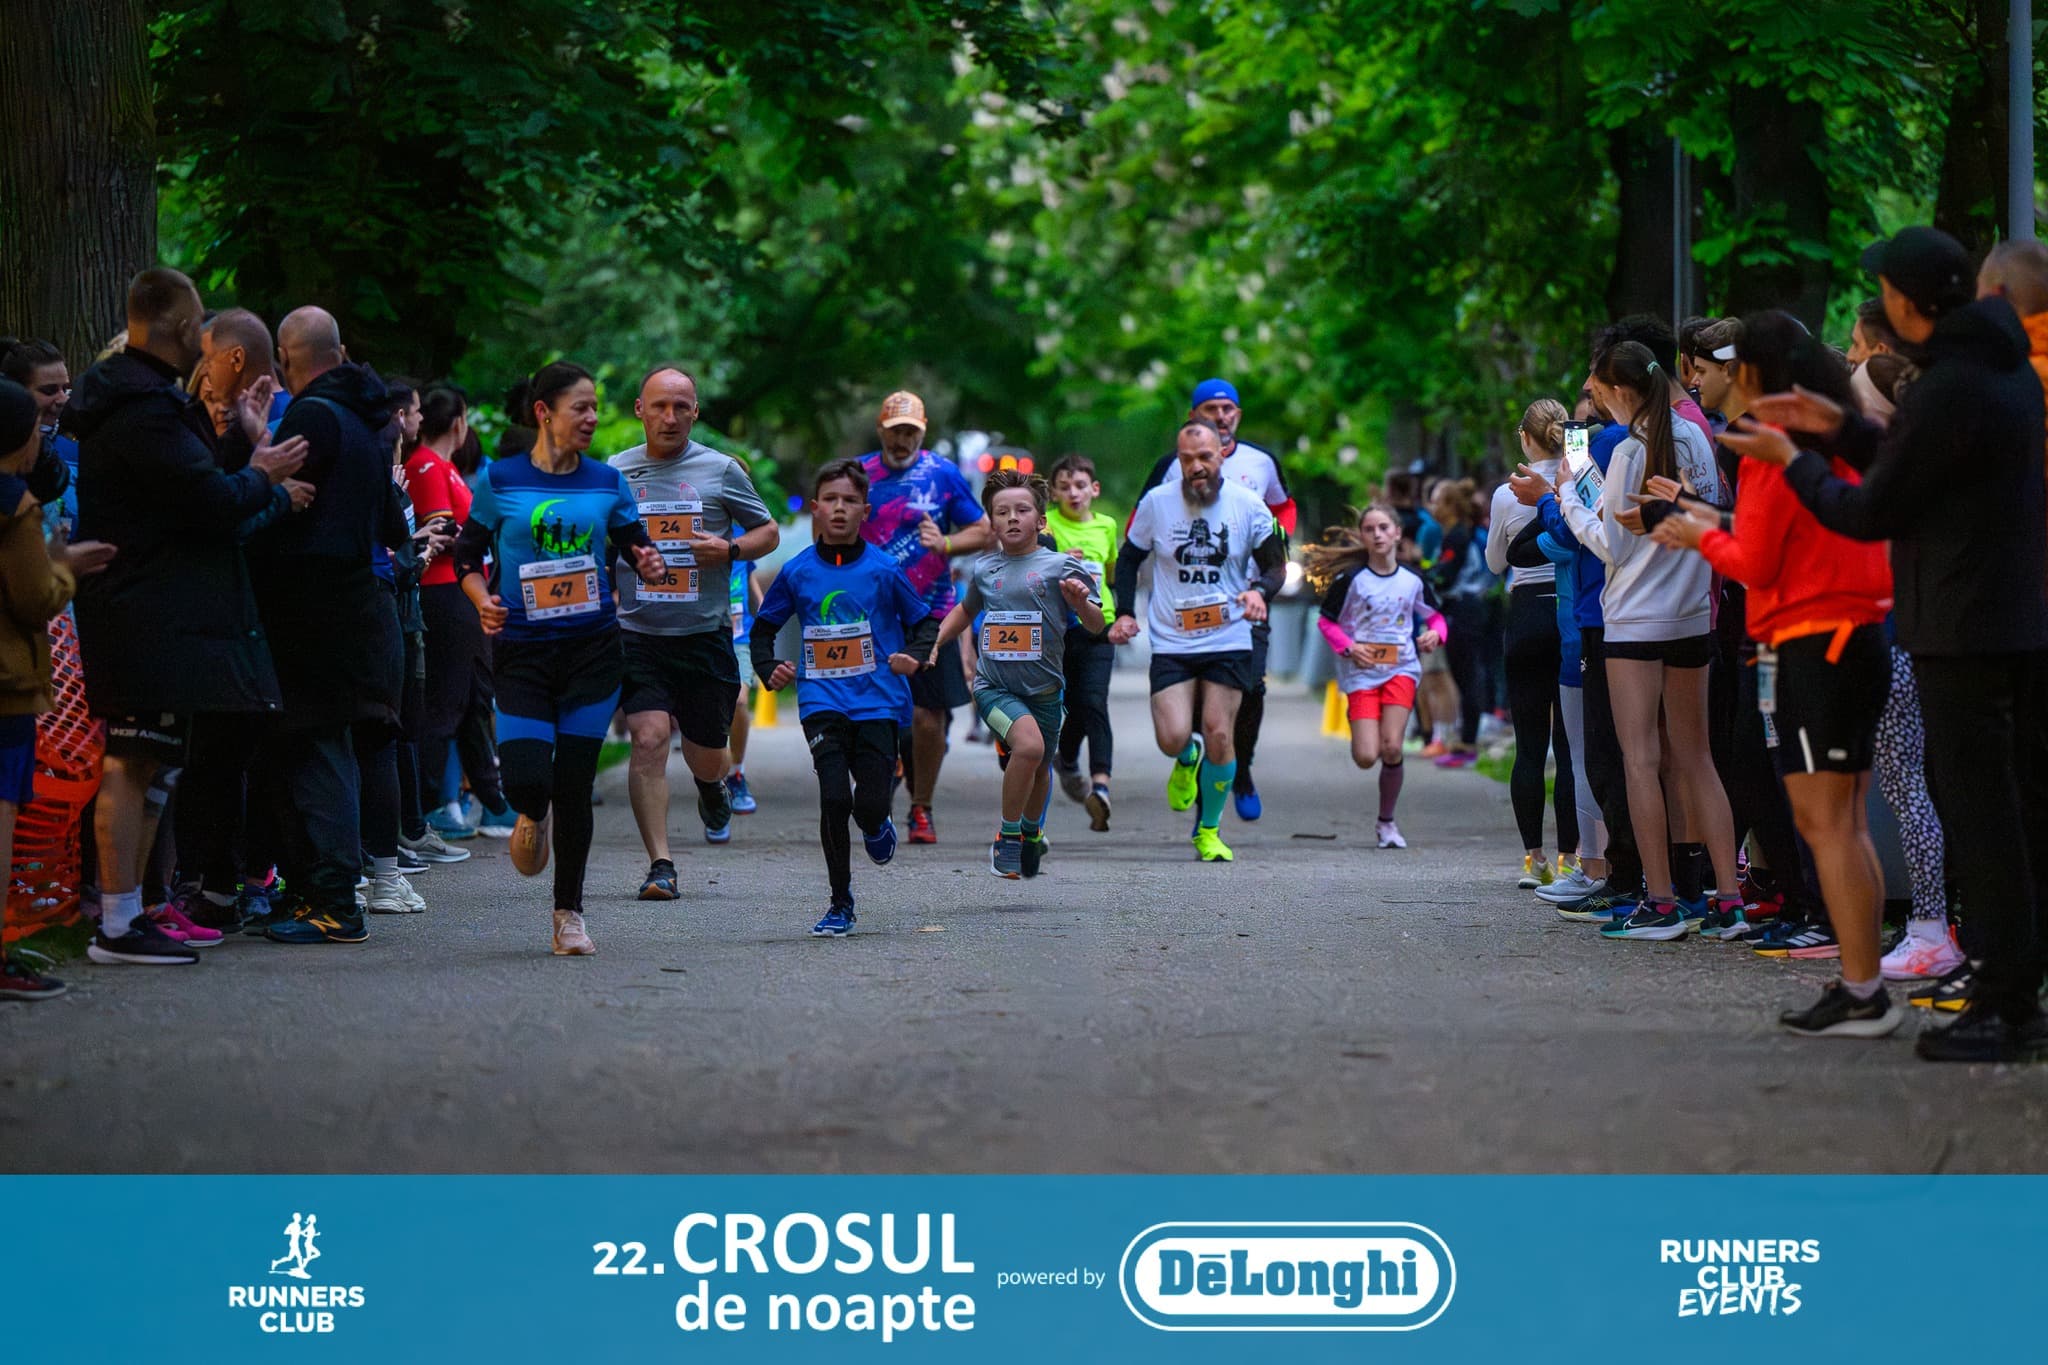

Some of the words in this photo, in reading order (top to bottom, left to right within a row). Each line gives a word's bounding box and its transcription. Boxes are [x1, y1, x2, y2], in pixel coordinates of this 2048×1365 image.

[659, 520, 680, 533] 24
[1178, 570, 1221, 585] DAD
[549, 581, 573, 598] 47
[1193, 612, 1211, 624] 22
[998, 630, 1019, 644] 24
[826, 645, 848, 660] 47
